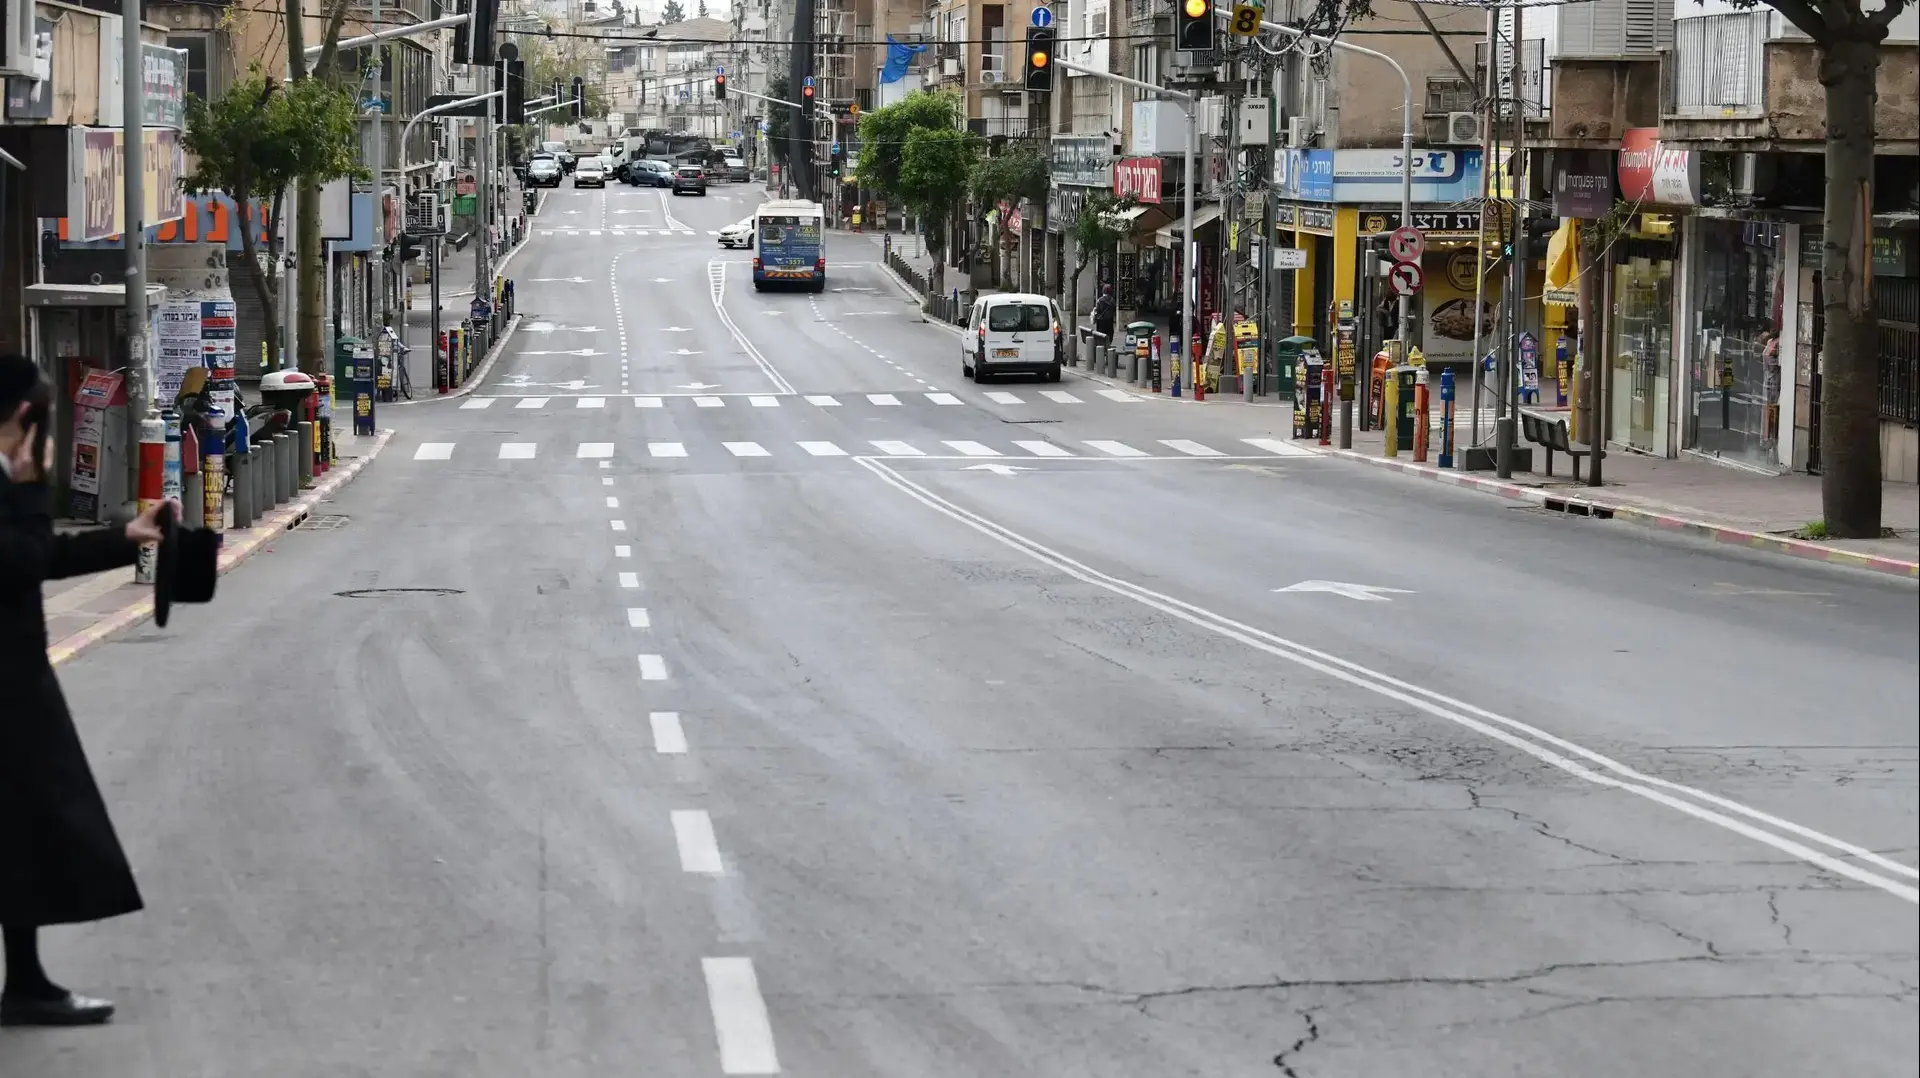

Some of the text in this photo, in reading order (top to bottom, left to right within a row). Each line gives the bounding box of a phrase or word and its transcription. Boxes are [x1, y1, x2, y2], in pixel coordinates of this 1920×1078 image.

[1236, 9, 1256, 31] 8
[1393, 155, 1424, 168] כל
[1620, 147, 1648, 172] Triumph
[1311, 160, 1331, 175] מרדכי
[1566, 174, 1594, 189] marquise
[1392, 213, 1448, 229] הצי
